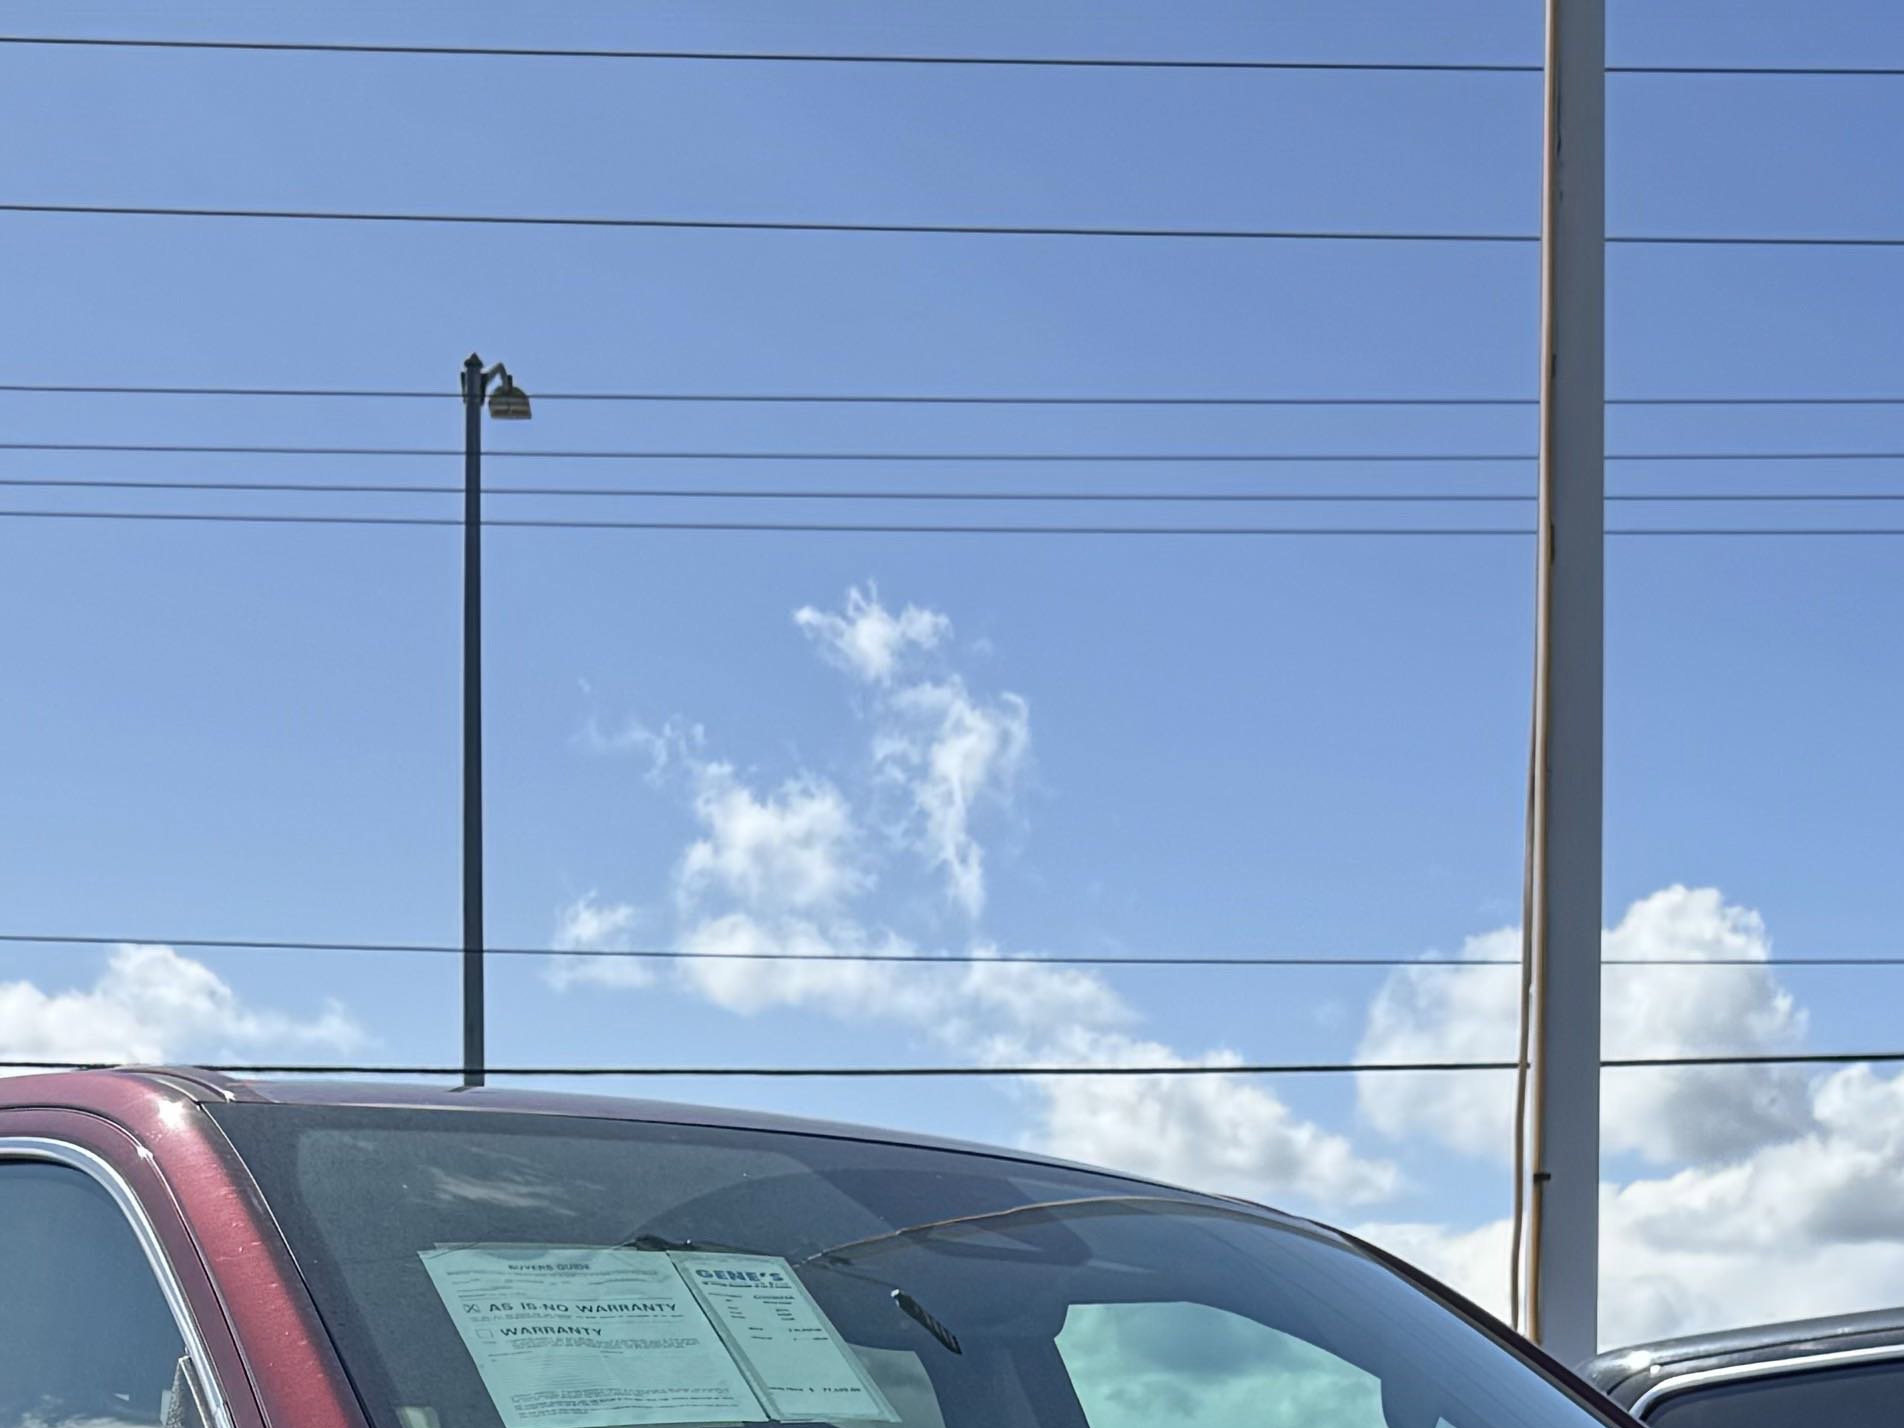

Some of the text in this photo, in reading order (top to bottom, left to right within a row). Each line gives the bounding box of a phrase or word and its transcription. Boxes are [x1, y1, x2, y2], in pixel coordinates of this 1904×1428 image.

[695, 1269, 785, 1282] GENE'S
[489, 1303, 514, 1312] AS
[576, 1303, 677, 1313] WARRANTY
[500, 1326, 603, 1336] WARRANTY
